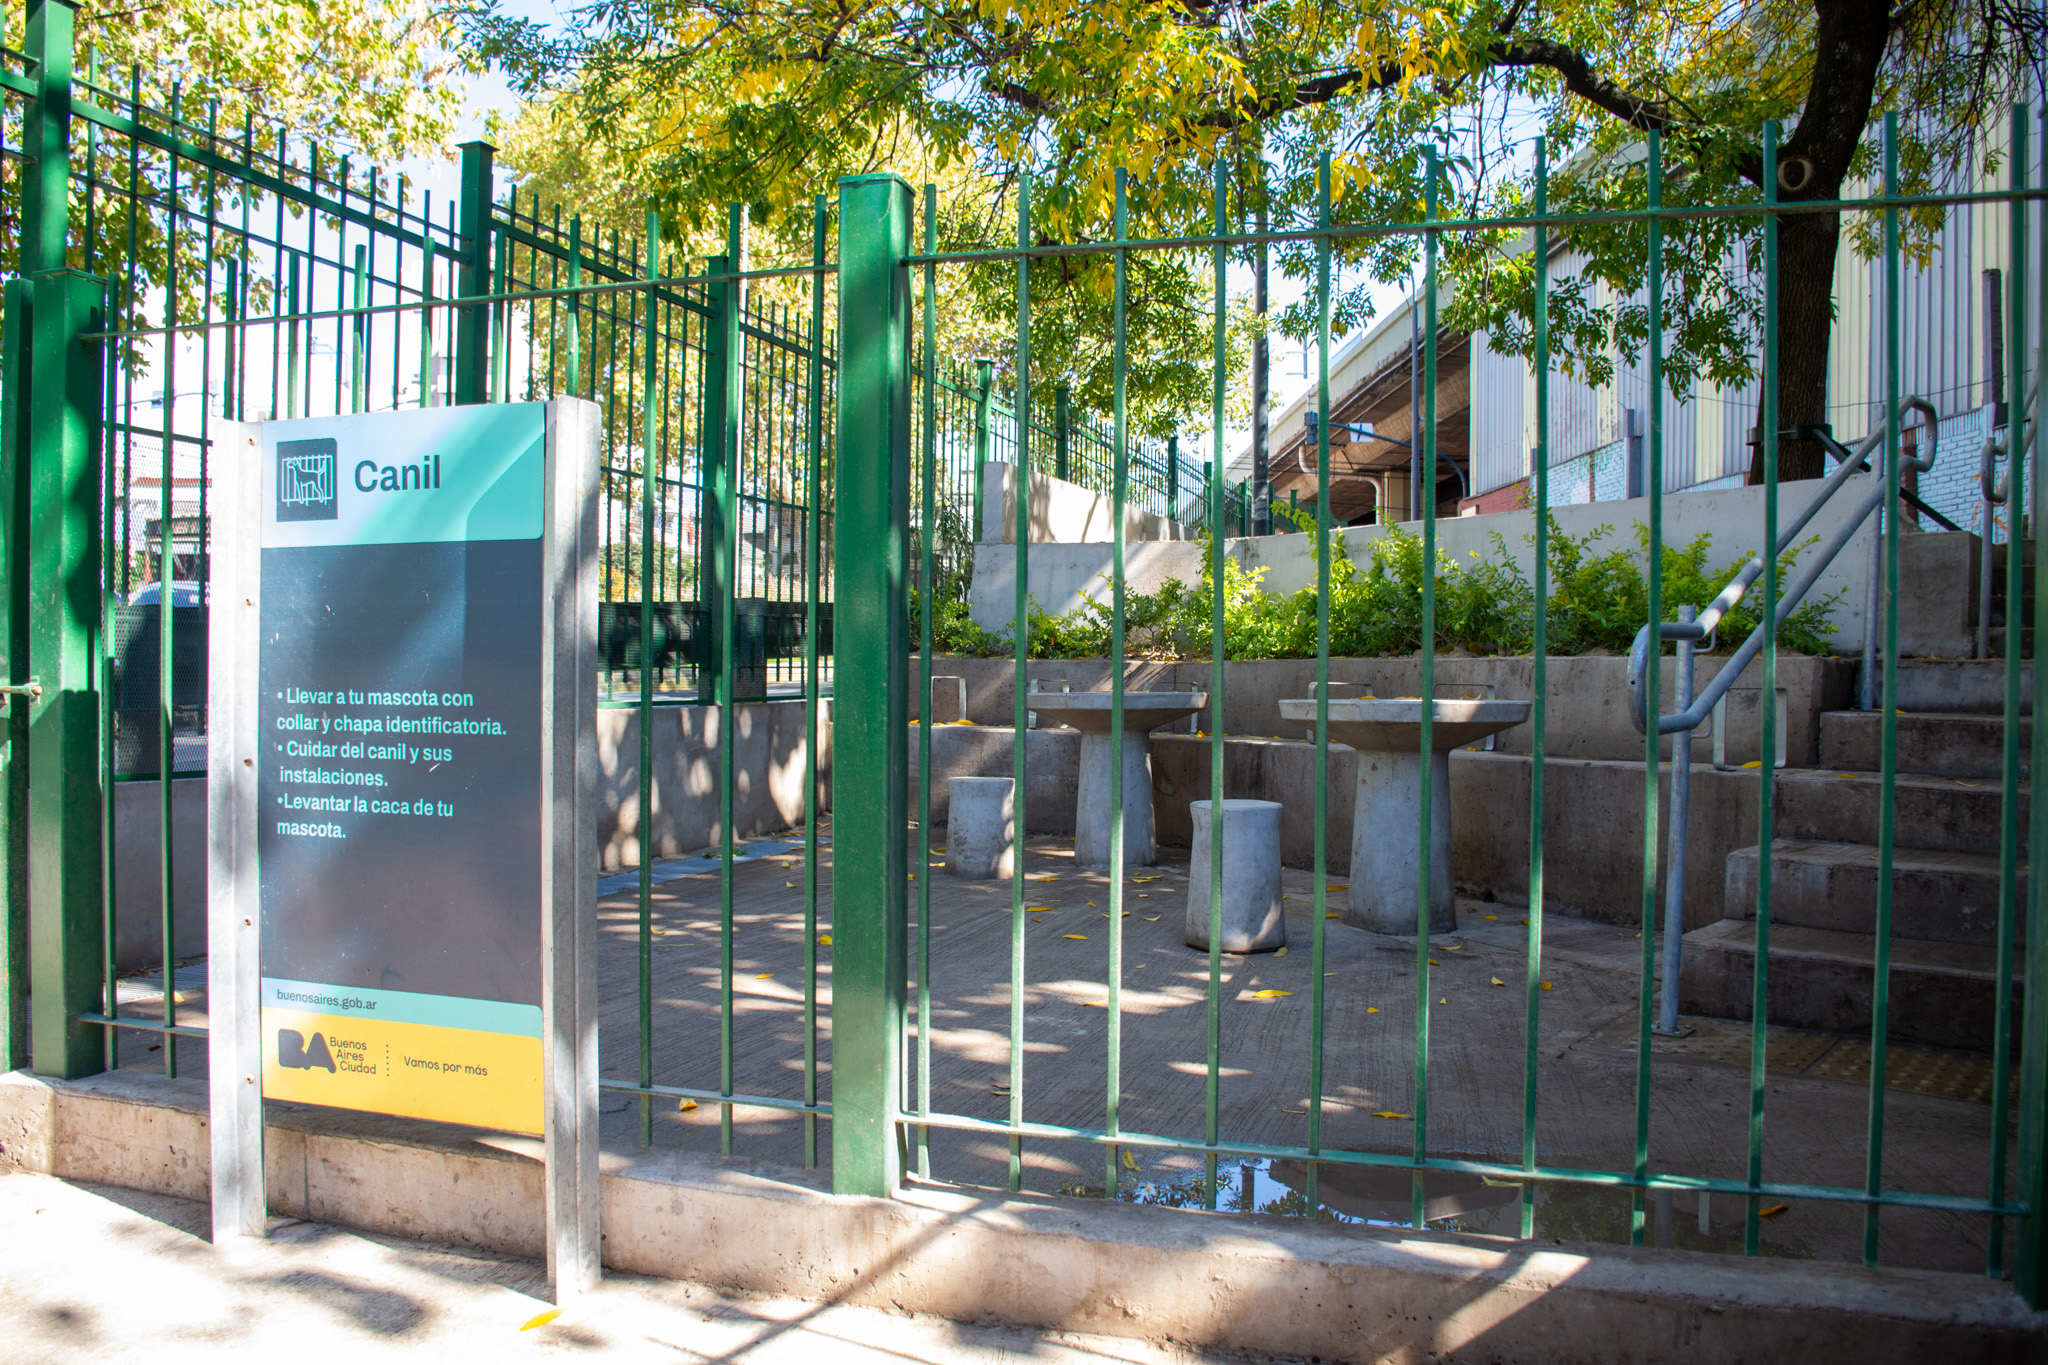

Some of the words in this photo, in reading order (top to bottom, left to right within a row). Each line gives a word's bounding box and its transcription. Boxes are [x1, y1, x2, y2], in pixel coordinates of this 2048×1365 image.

[355, 455, 440, 492] Canil
[287, 688, 333, 704] Llevar
[336, 692, 346, 704] a
[349, 689, 364, 705] tu
[368, 690, 439, 706] mascota
[442, 693, 474, 706] con
[277, 714, 319, 730] collar
[322, 717, 331, 734] y
[334, 715, 383, 735] chapa
[386, 716, 507, 735] identificatoria.
[287, 741, 338, 757] Cuidar
[341, 742, 364, 758] del
[368, 743, 406, 759] canil
[410, 747, 420, 764] y
[423, 747, 453, 761] sus
[280, 766, 388, 786] instalaciones.
[284, 793, 351, 812] Levantar
[354, 796, 368, 813] la
[372, 800, 410, 814] caca
[414, 799, 434, 815] de
[438, 801, 453, 816] tu
[277, 821, 347, 838] mascota.
[277, 989, 377, 1010] buenosaires.gob.ar
[330, 1037, 367, 1050] Buenos
[336, 1049, 364, 1061] Aires
[340, 1061, 376, 1074] Ciudad
[404, 1056, 439, 1071] Vamos
[443, 1063, 462, 1074] por
[465, 1065, 488, 1075] más
